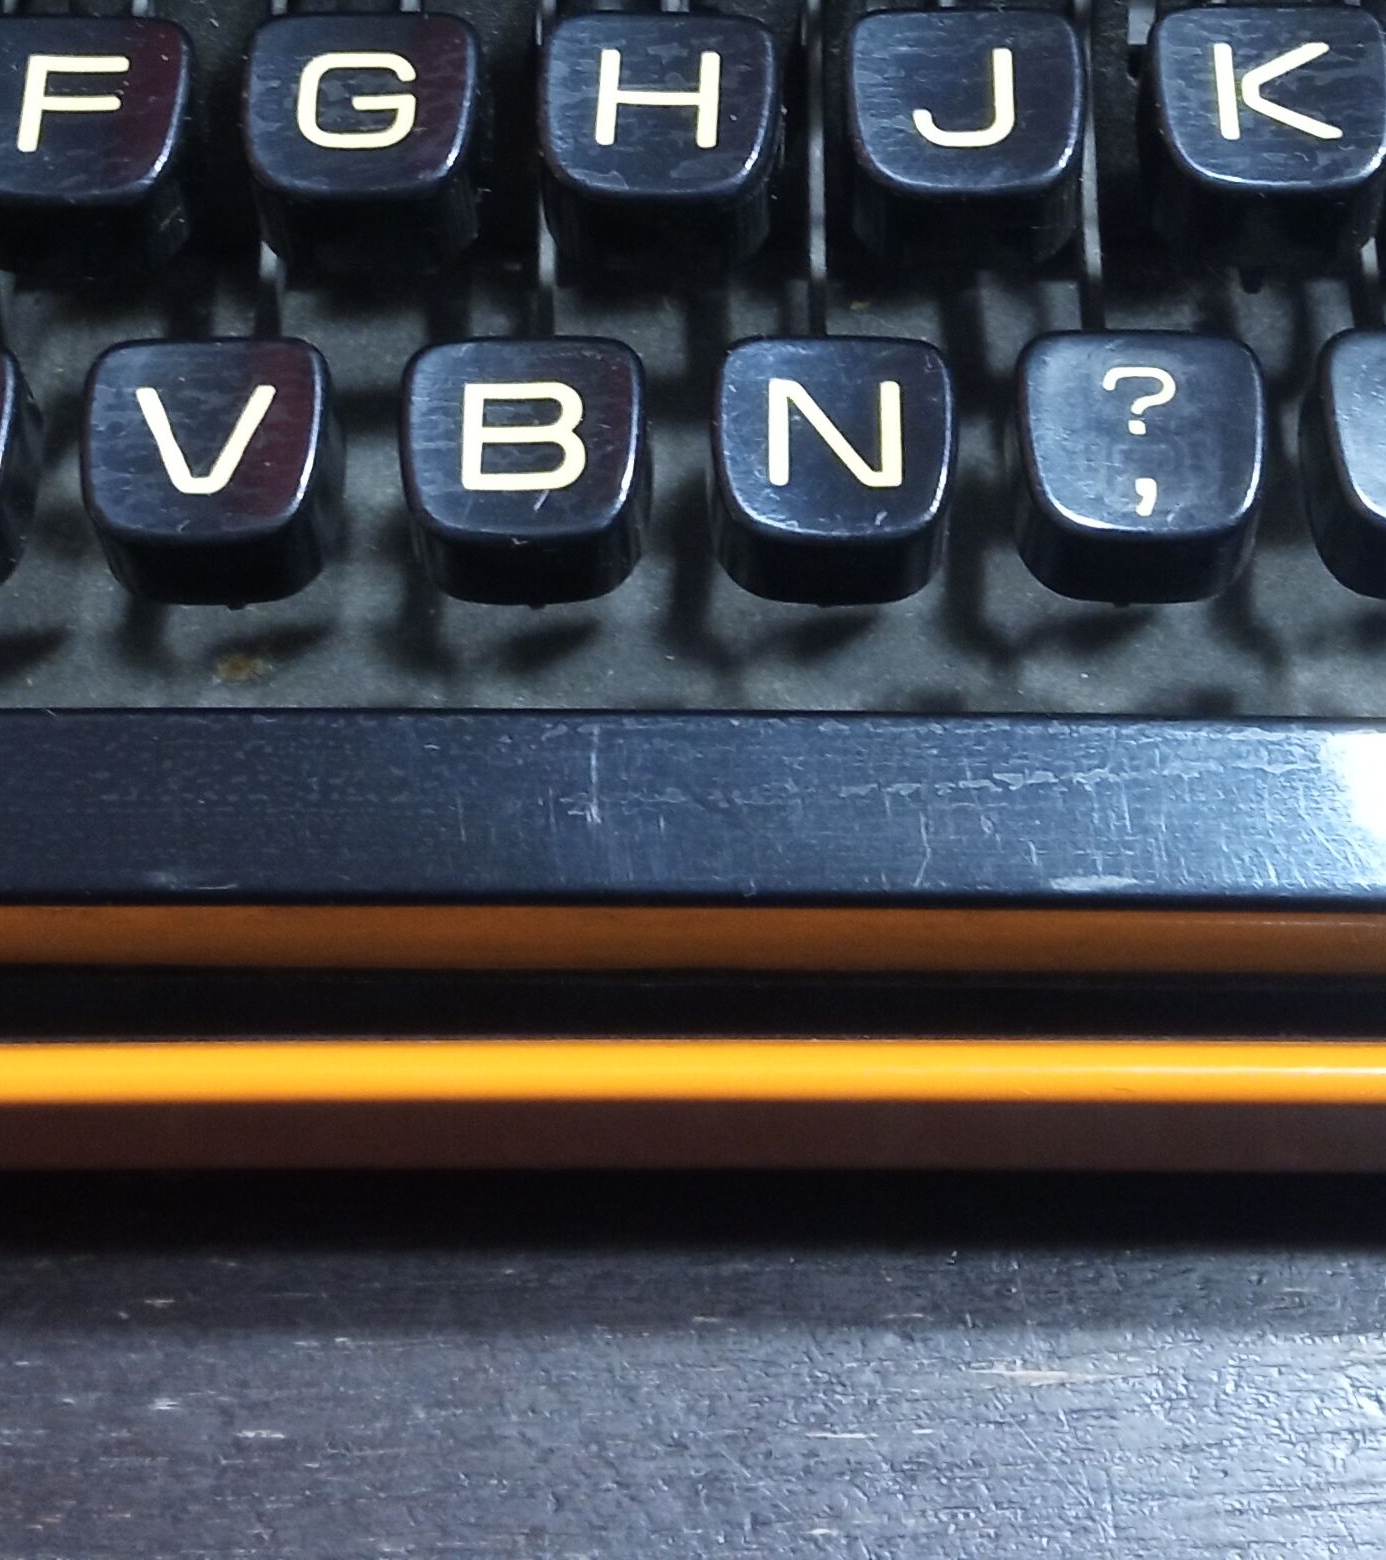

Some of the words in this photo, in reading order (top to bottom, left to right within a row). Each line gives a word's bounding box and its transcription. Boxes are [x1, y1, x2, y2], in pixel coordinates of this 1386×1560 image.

[16, 54, 130, 153] F
[296, 52, 417, 149] G
[594, 48, 721, 148] H
[912, 47, 1015, 147] J
[1212, 42, 1343, 141] K
[135, 384, 276, 495] V
[460, 381, 586, 491] B
[767, 376, 903, 488] N
[1102, 366, 1177, 435] ?
